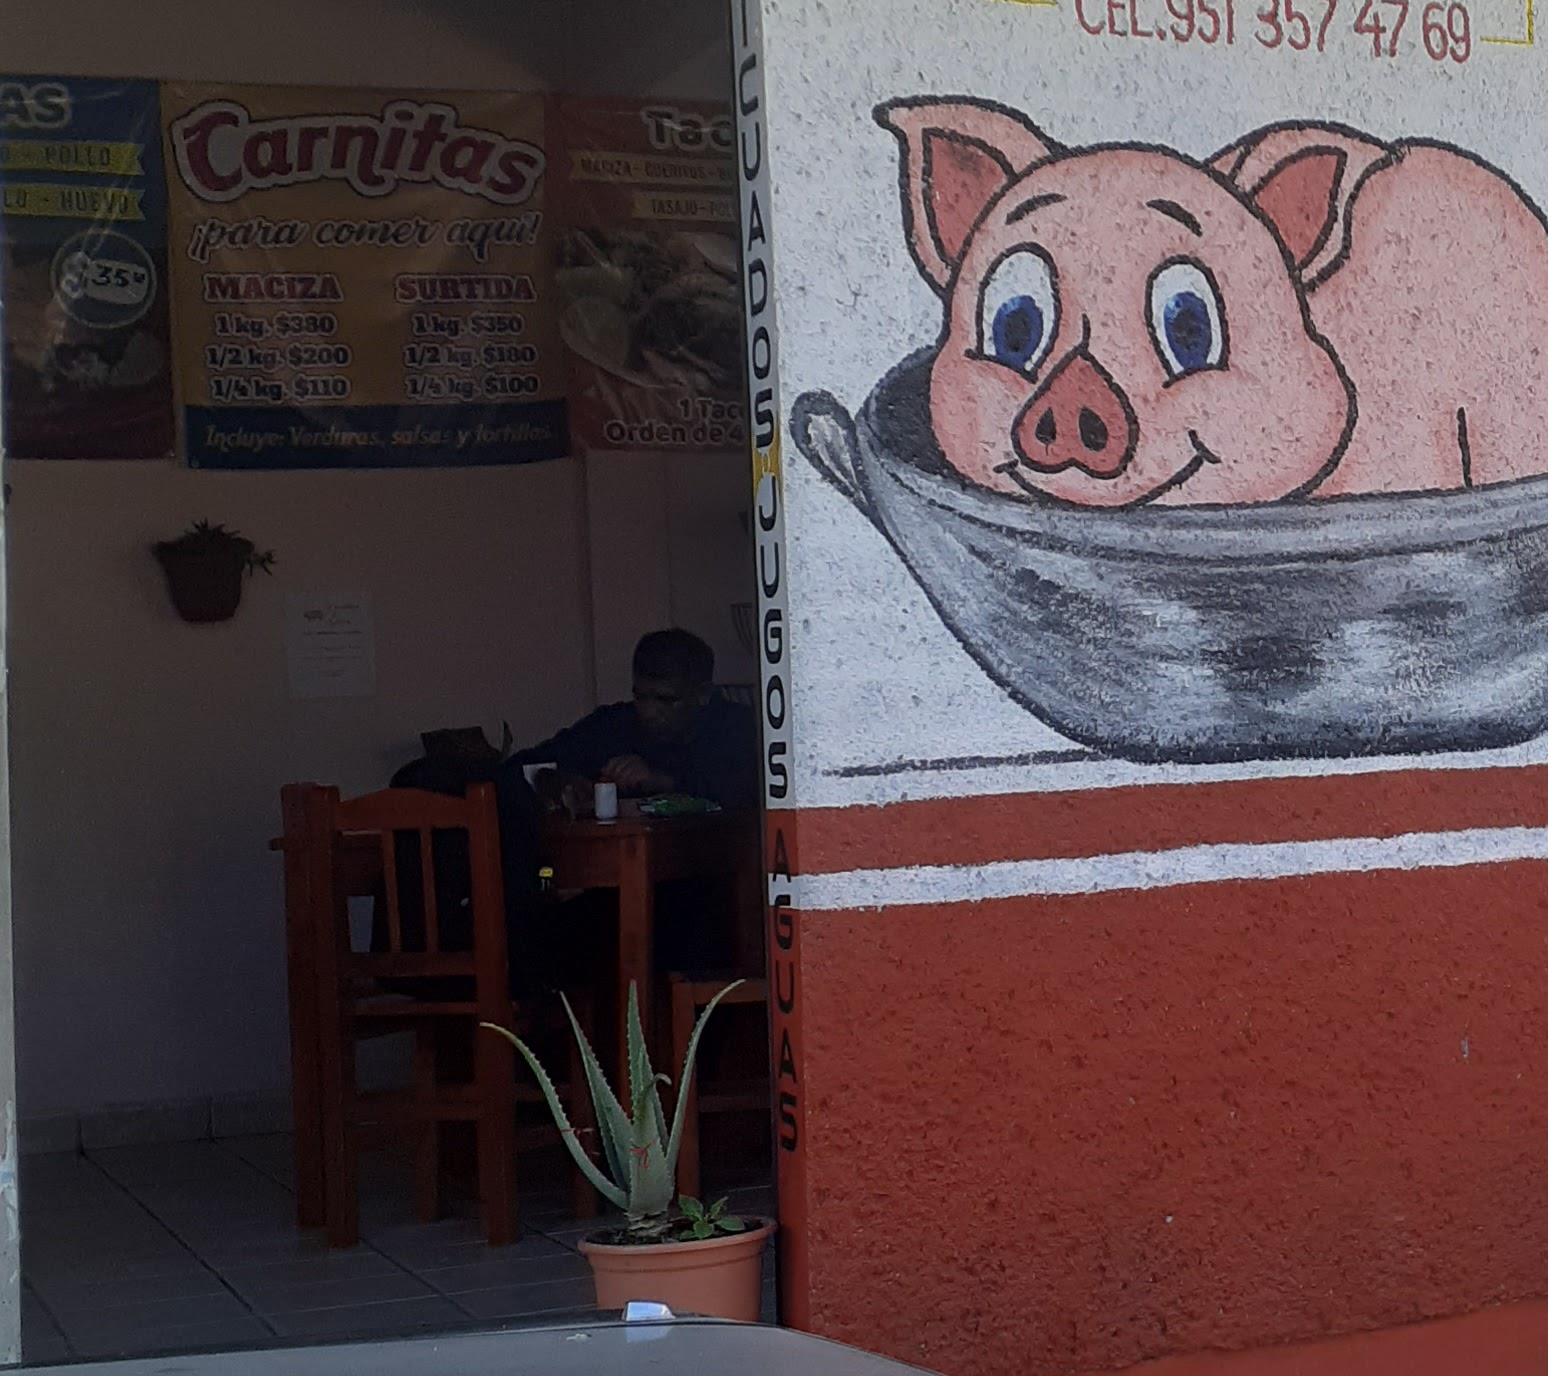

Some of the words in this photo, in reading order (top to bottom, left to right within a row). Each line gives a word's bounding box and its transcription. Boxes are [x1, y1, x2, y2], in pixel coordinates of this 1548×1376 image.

[1355, 0, 1409, 57] 47
[1423, 2, 1471, 63] 69
[647, 111, 732, 146] Tac
[184, 111, 537, 194] Carnitas
[316, 223, 438, 245] comer
[207, 276, 341, 299] MACIZA
[399, 277, 534, 300] SURTIDA
[218, 317, 228, 333] 1
[415, 316, 426, 332] 1
[209, 347, 242, 368] 1/2
[289, 345, 348, 366] $200
[407, 347, 440, 365] 1/2
[698, 400, 743, 419] Tac
[607, 422, 686, 442] Orden
[756, 472, 789, 799] JUGOS
[771, 827, 797, 1152] AGUAS
